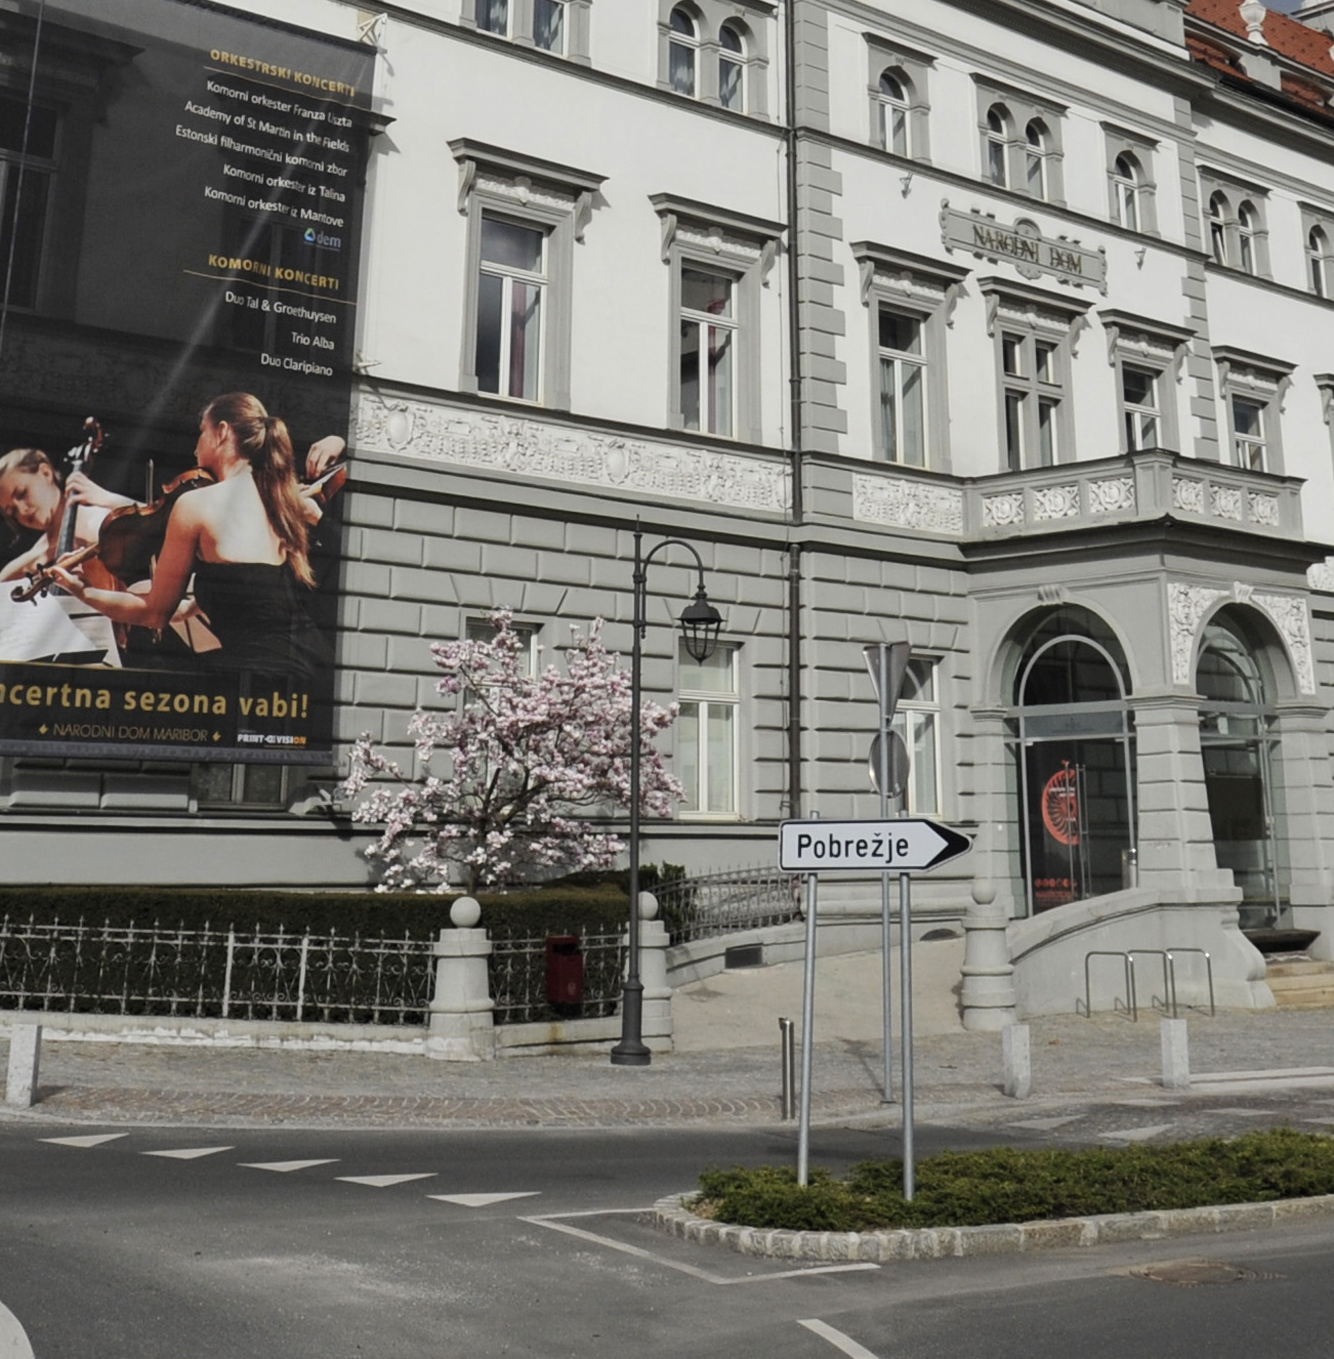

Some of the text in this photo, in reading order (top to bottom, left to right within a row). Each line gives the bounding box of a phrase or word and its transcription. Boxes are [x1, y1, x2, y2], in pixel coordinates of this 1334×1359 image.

[210, 49, 355, 97] ORKESTRSKI KONCERTI
[207, 80, 249, 102] Komorni
[251, 94, 292, 113] orkester
[293, 104, 325, 121] Franza
[184, 100, 350, 152] Academy of St Martin in the Fields
[175, 124, 348, 177] Estonski filharmonični komorni zbor
[223, 163, 264, 184] Komorni
[266, 176, 306, 193] orkester
[308, 184, 317, 196] iz
[204, 186, 345, 228] Komorni orkester iz Mantove
[317, 231, 342, 248] dem
[972, 224, 1082, 274] NARODNI DOM
[208, 254, 339, 290] KOMORNI KONCERTI
[225, 291, 336, 324] Duo Tal & Groethuysen
[291, 332, 335, 350] Trio Alba
[261, 353, 333, 376] Duo Claripiano
[124, 691, 226, 715] sezona
[239, 691, 308, 719] vabi!
[53, 723, 208, 742] NARODNI DOM MARIBOR
[797, 832, 909, 864] Pobrežje
